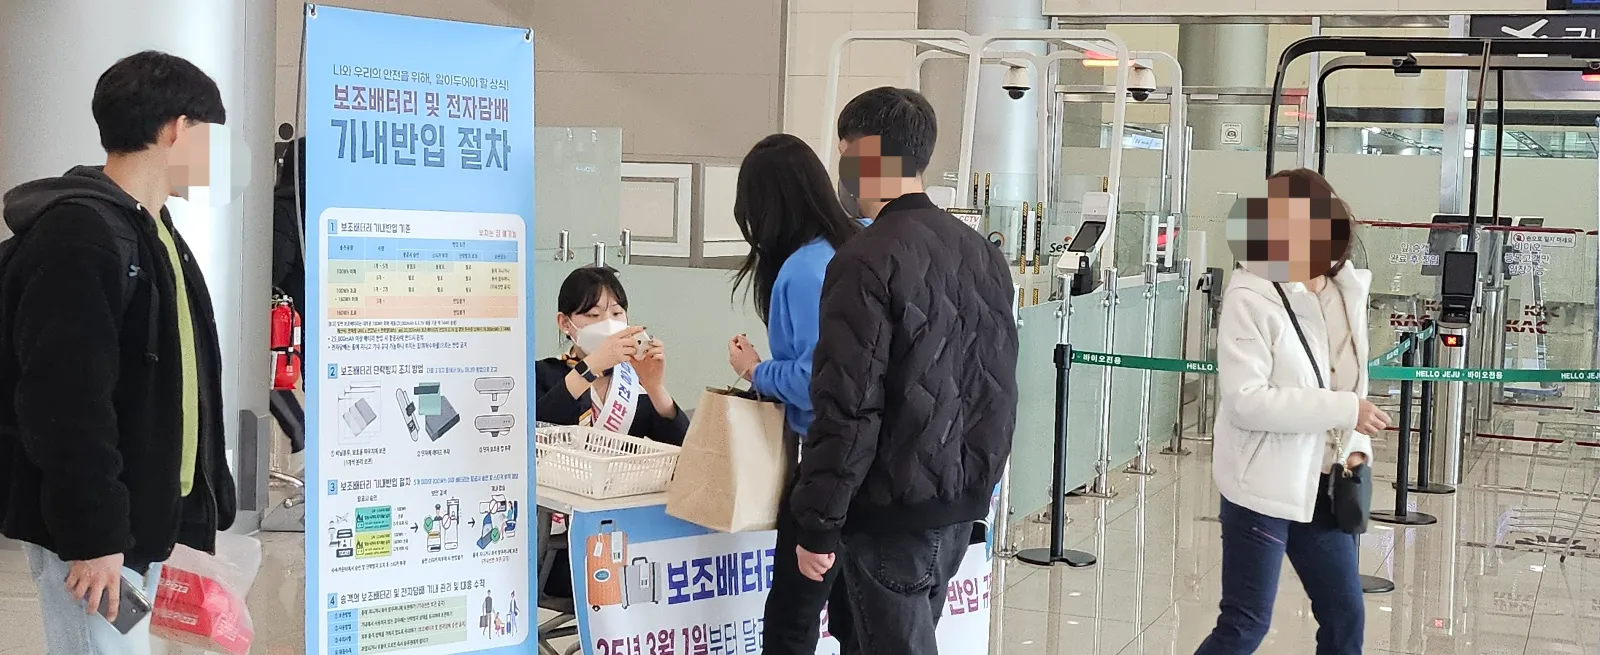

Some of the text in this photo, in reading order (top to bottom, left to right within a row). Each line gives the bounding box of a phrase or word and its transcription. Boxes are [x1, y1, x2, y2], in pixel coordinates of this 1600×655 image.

[333, 64, 351, 77] 나와
[354, 66, 381, 80] 우리의
[383, 68, 409, 82] 안전을
[411, 71, 432, 85] 위해,
[480, 77, 488, 89] 할
[490, 79, 509, 91] 상식!
[333, 84, 509, 122] 보조배터리 및 전자담배
[331, 118, 511, 172] 기내반입 절차
[341, 222, 373, 232] 보조배터리
[374, 223, 398, 233] 기내반입
[1514, 242, 1542, 252] 바이오
[1505, 320, 1548, 334] KAC
[1083, 353, 1122, 365] 바이오전용
[341, 365, 372, 376] 보조배터리
[1186, 362, 1213, 372] HELLO
[1416, 370, 1503, 380] HELLO JEJU 바이오전용
[341, 480, 372, 491] 보조배터리
[374, 478, 397, 488] 기내반입
[341, 593, 360, 604] 승객의
[362, 590, 392, 601] 보조배터리
[394, 589, 399, 598] 및
[401, 586, 424, 598] 전자담배
[427, 584, 438, 593] 기내
[441, 583, 451, 593] 관리
[454, 582, 458, 591] 및
[460, 580, 472, 590] 대응
[947, 578, 979, 616] 반입
